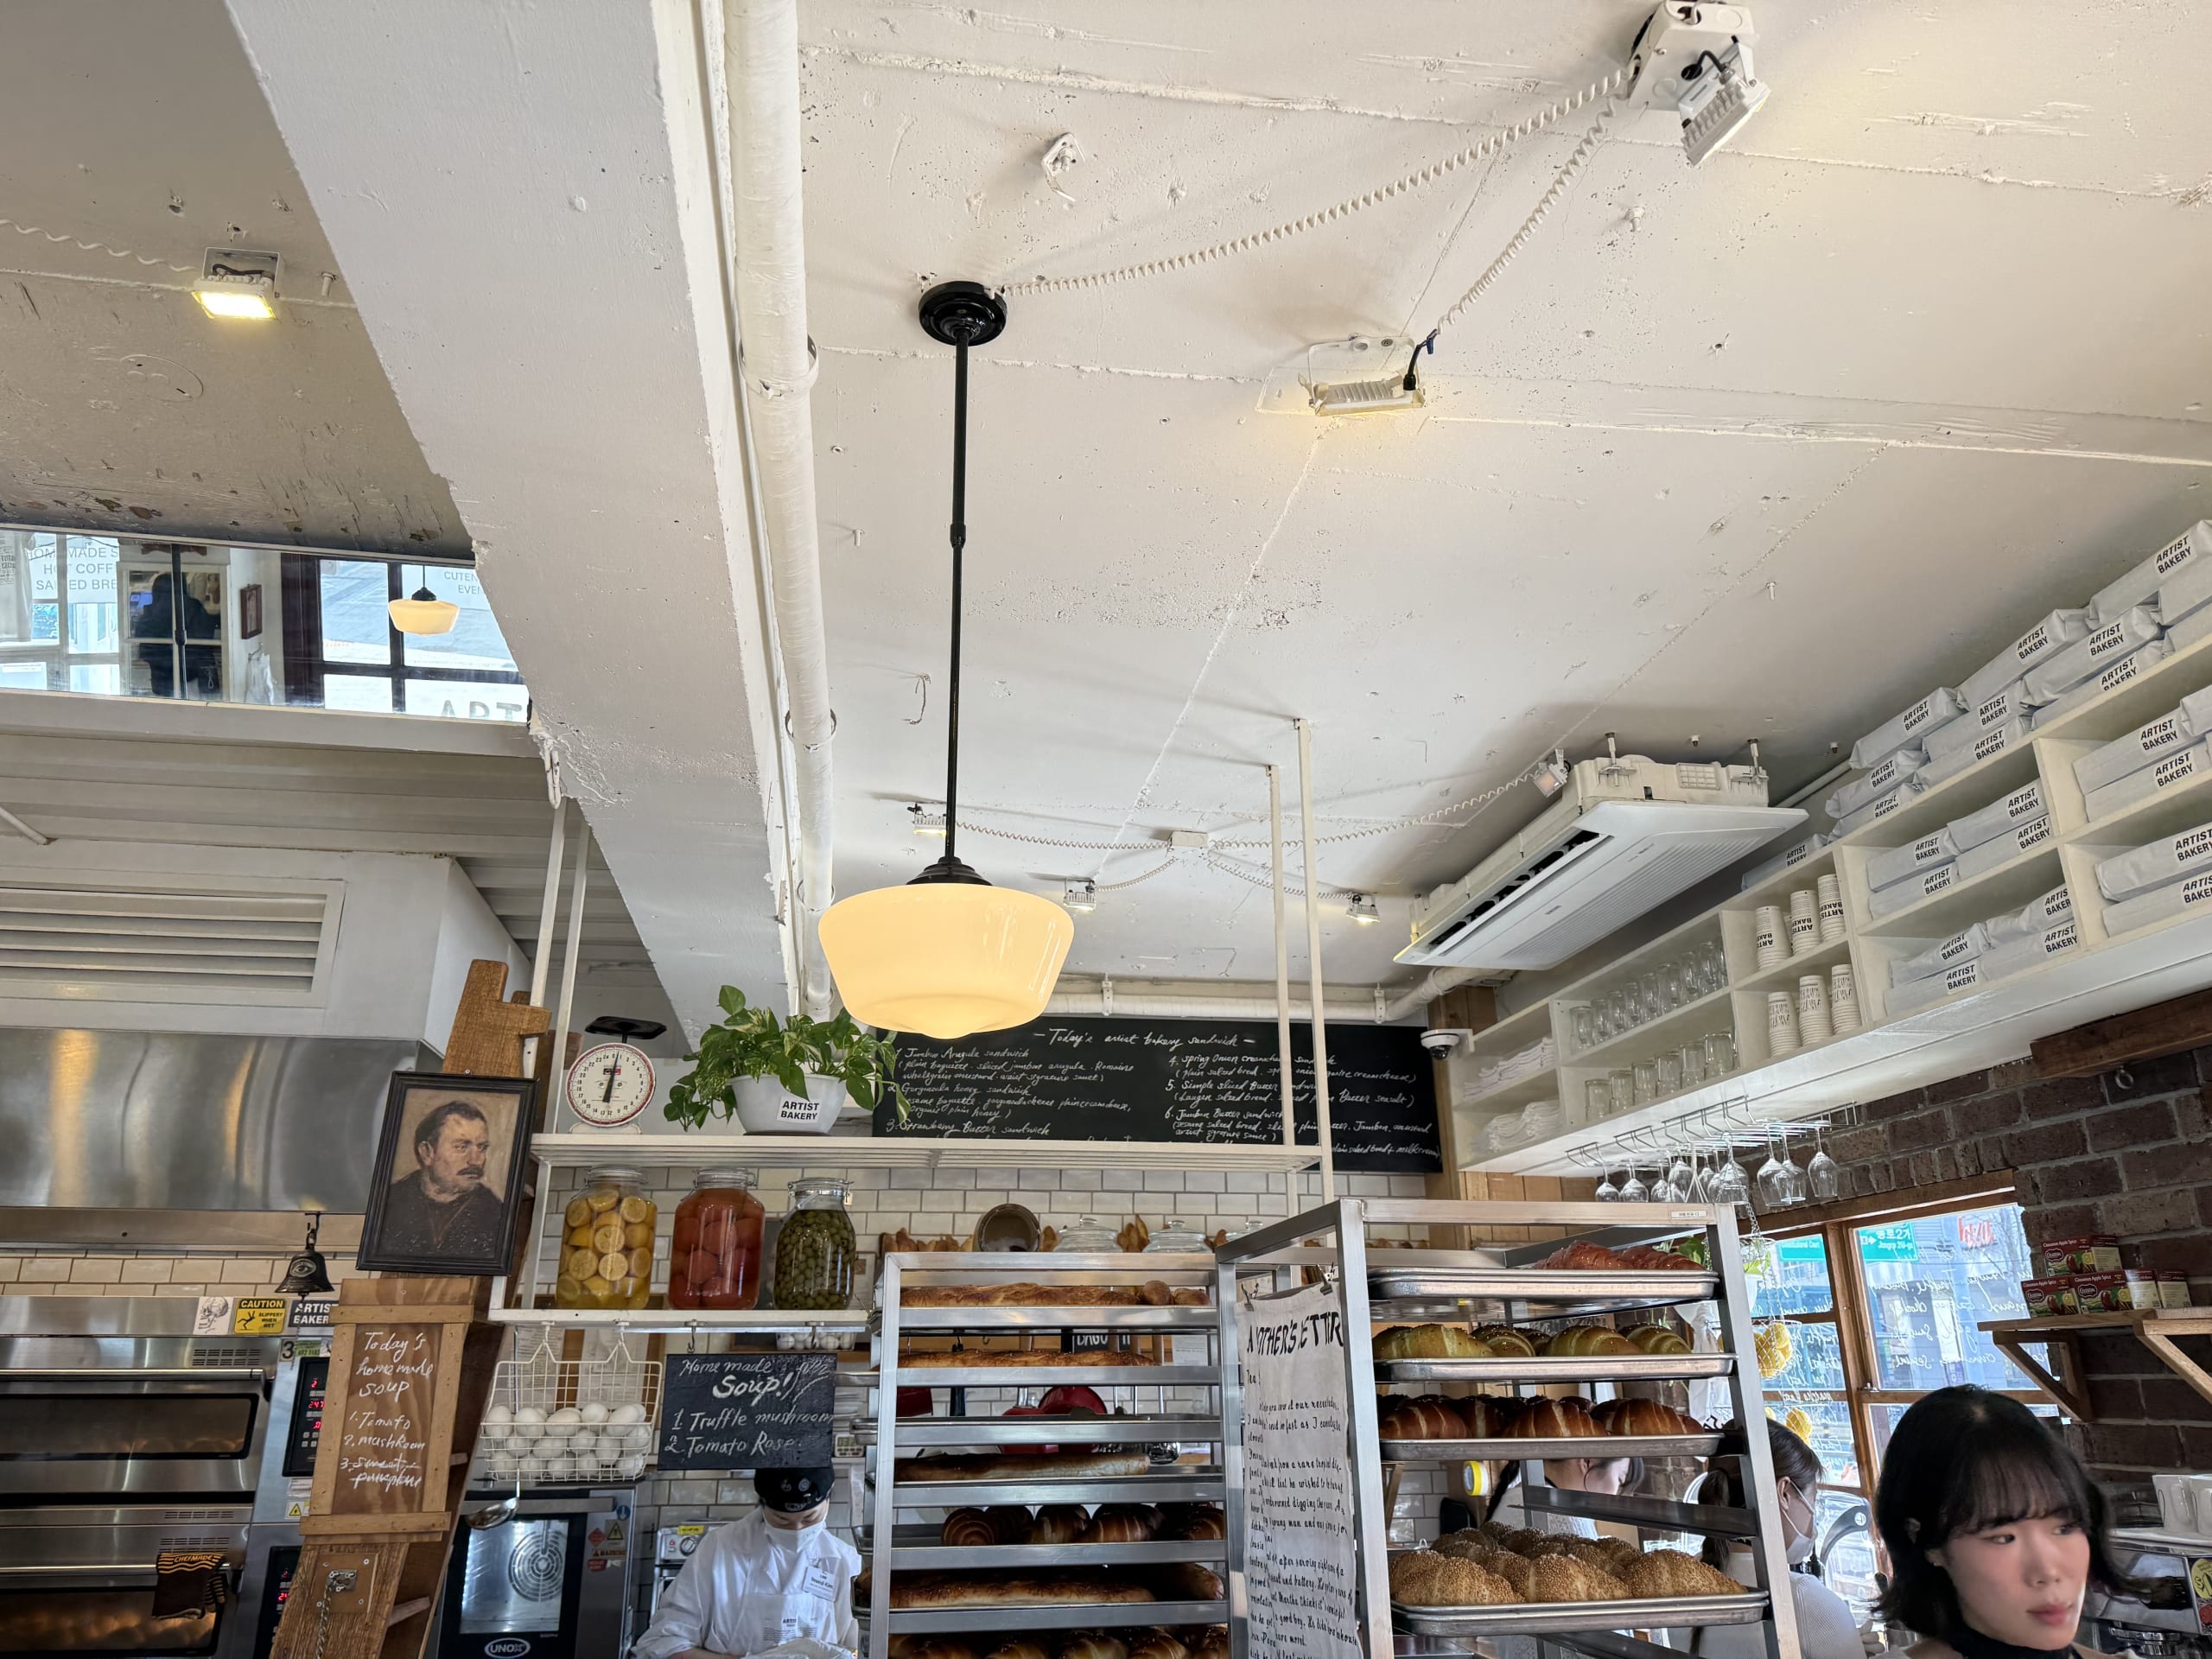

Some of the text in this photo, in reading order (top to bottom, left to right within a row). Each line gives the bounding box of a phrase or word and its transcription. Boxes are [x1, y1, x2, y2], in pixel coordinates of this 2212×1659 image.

[2155, 536, 2190, 565] ARTIST
[2158, 547, 2191, 574] BAKERY
[76, 564, 113, 574] COFF
[2017, 626, 2045, 651] ARTIST
[2088, 623, 2121, 646] ARTIST
[2090, 632, 2124, 657] BAKERY
[2018, 636, 2048, 660] BAKERY
[2101, 658, 2135, 685] ARTIST
[1903, 701, 1928, 722] ARTIST
[1979, 696, 2005, 716] ARTIST
[1981, 704, 2008, 725] BAKERY
[1904, 709, 1929, 731] BAKERY
[2140, 719, 2173, 742] ARTIST
[2143, 728, 2178, 752] BAKERY
[1974, 730, 2004, 752] ARTIST
[1975, 739, 2005, 760] BAKERY
[1870, 760, 1894, 780] ARTIST
[2155, 752, 2191, 778] ARTIST
[2158, 762, 2193, 787] BAKERY
[1872, 769, 1896, 788] BAKERY
[2008, 788, 2036, 809] ARTIST
[2009, 798, 2040, 818] BAKERY
[2018, 817, 2047, 840] ARTIST
[2019, 827, 2050, 849] BAKERY
[1786, 844, 1806, 859] ARTIST
[1915, 837, 1938, 852] ARTIST
[1916, 846, 1939, 861] BAKERY
[1924, 868, 1949, 887] ARTIST
[1925, 876, 1951, 895] BAKERY
[2183, 874, 2212, 893] ARTIS
[2045, 888, 2069, 906] ARTIS
[2184, 883, 2212, 904] BAKE
[1821, 908, 1844, 919] ARTIS
[2046, 898, 2070, 916] BAKER
[1791, 924, 1813, 935] ARTIS
[2044, 925, 2075, 944] ARTIST
[1942, 941, 1968, 960] BAKERY
[2045, 935, 2078, 953] BAKERY
[1947, 964, 1974, 980] ARTIST
[1948, 973, 1976, 989] BAKERY
[1187, 1034, 1238, 1046] sandwich
[781, 1111, 818, 1121] BAKERY
[783, 1101, 820, 1111] ARTIST
[1001, 1122, 1052, 1135] sandwich
[283, 1341, 294, 1359] 3
[359, 1382, 410, 1403] soup
[690, 1408, 747, 1432] Truffle
[754, 1404, 835, 1425] mushroom
[686, 1436, 747, 1458] Tomato
[1293, 1496, 1315, 1512] digging
[490, 1643, 525, 1654] UNOX
